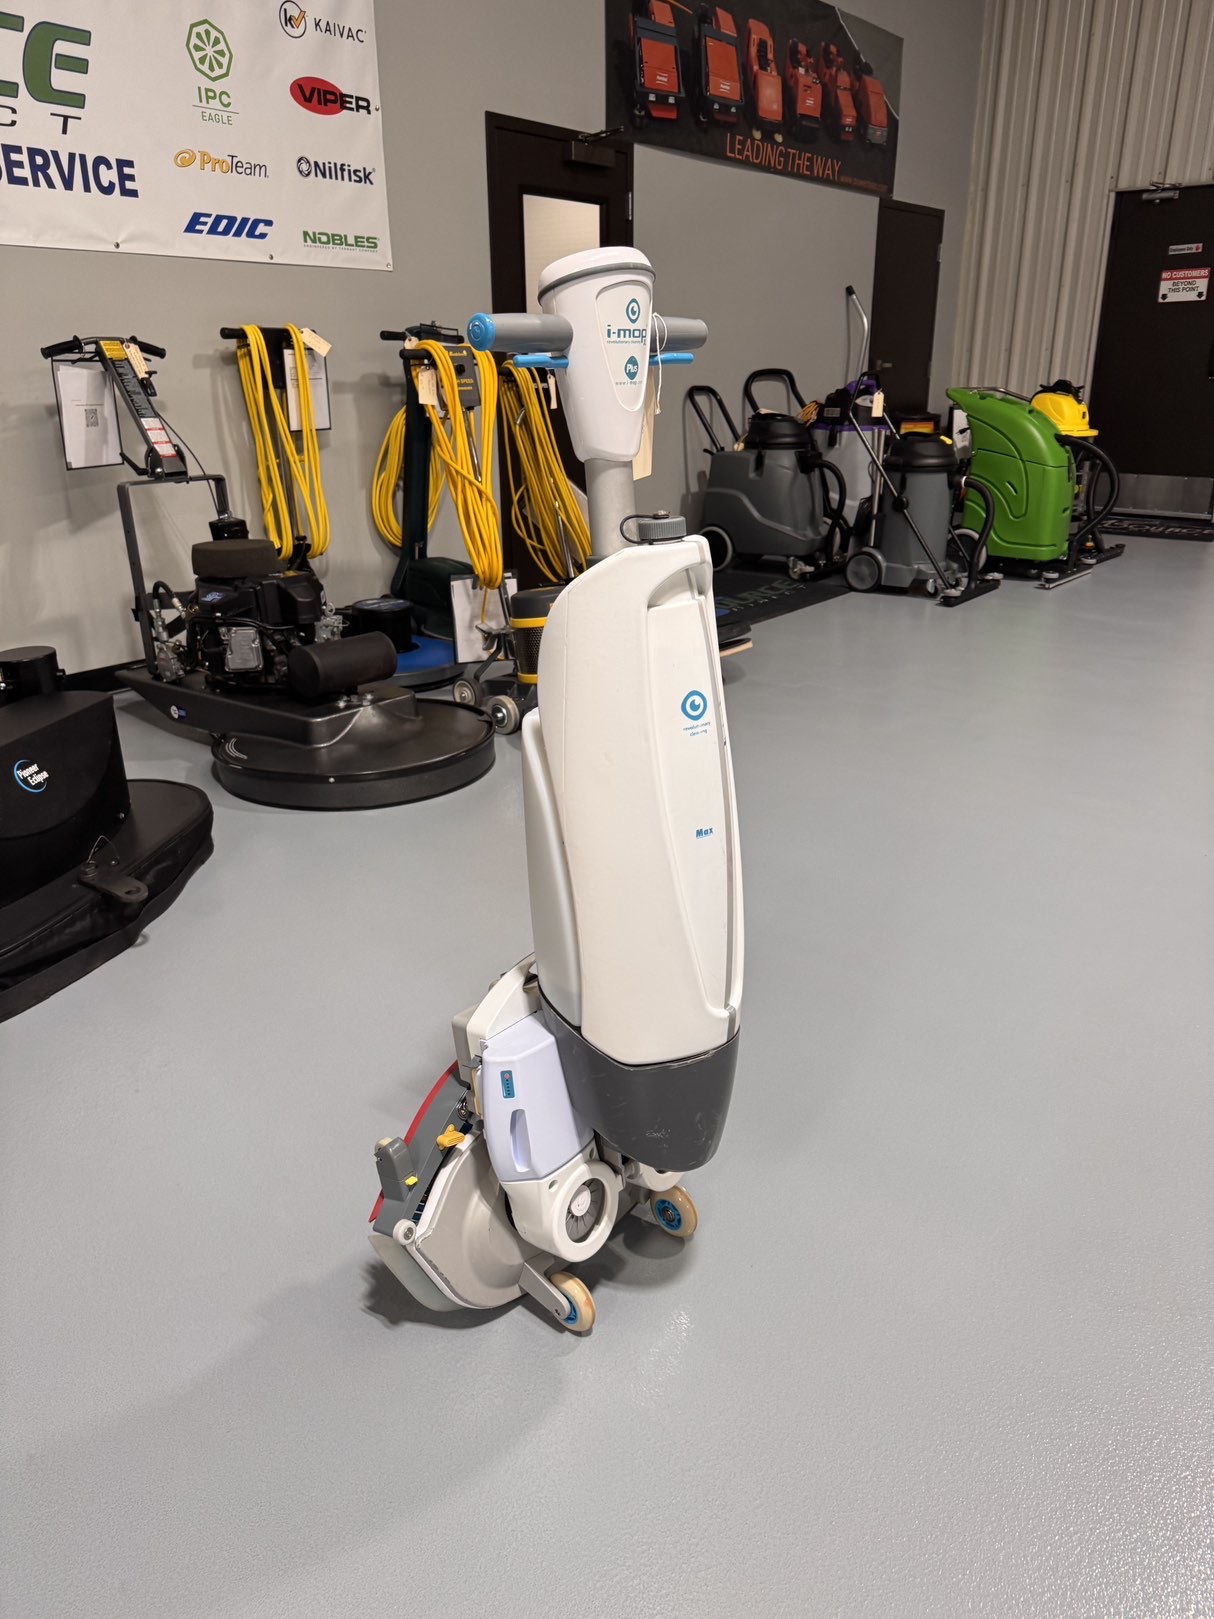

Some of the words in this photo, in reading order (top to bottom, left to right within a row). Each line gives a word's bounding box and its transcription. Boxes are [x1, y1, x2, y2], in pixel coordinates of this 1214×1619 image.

[313, 17, 365, 43] KAIVAC
[197, 86, 232, 109] IPC
[296, 83, 372, 115] VIPER
[201, 111, 233, 126] EAGLE
[198, 150, 269, 178] ProTeam
[726, 132, 785, 170] LEADING
[787, 149, 811, 175] THE
[813, 155, 842, 181] WAY
[0, 142, 139, 199] ERVICE
[313, 159, 375, 185] Nilfisk
[183, 211, 274, 240] EDIC
[302, 230, 378, 249] NOBLES
[1172, 270, 1208, 278] CUSTOMERS
[606, 324, 647, 343] i-mop
[626, 363, 638, 373] Plus
[17, 763, 39, 779] Pioneer
[28, 770, 49, 786] Eclipse
[695, 827, 714, 838] Max
